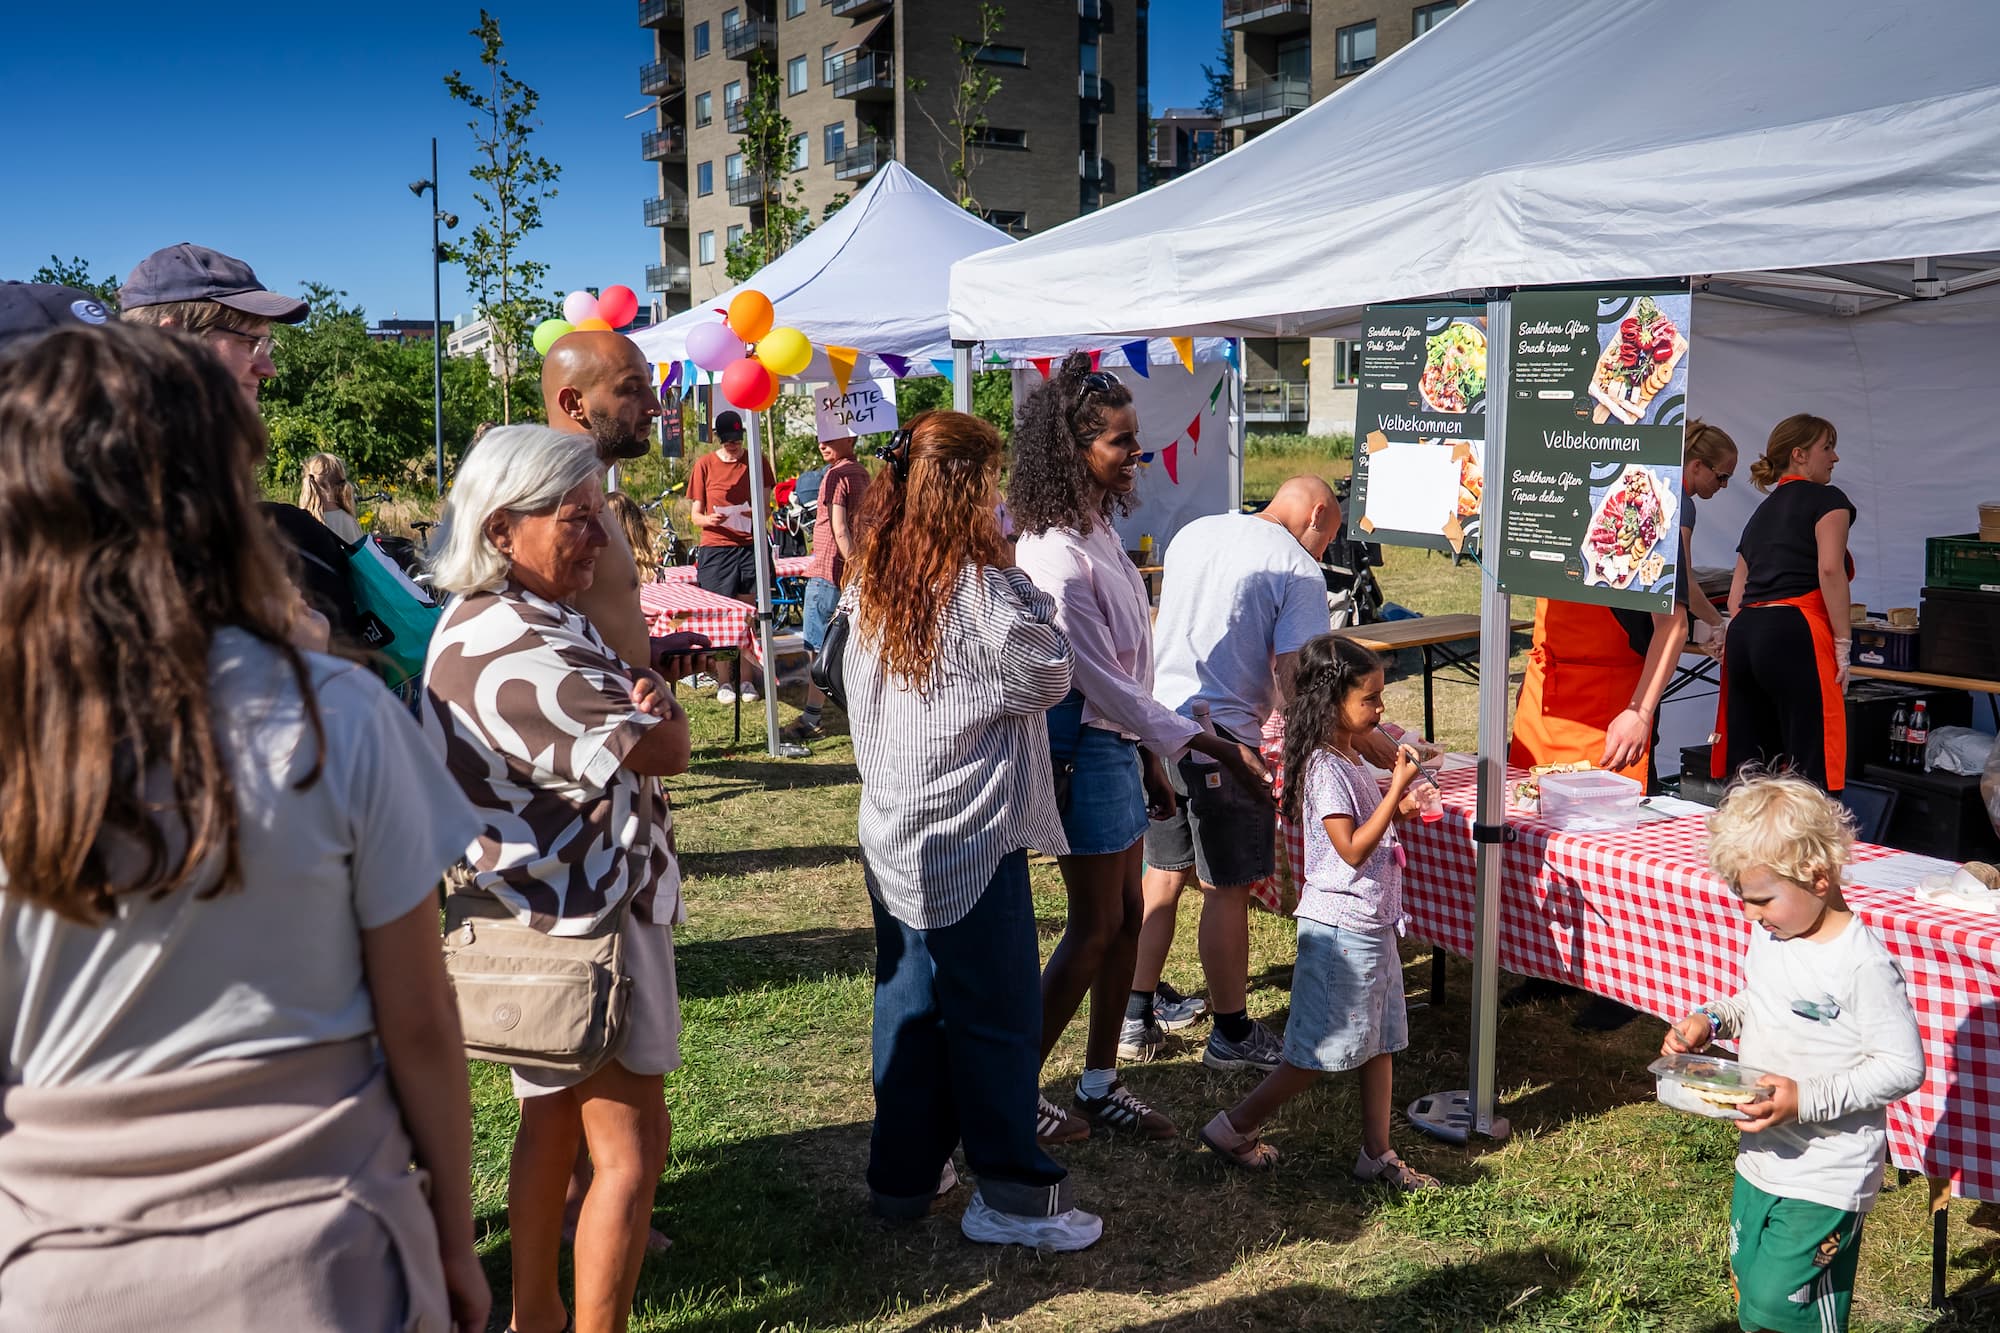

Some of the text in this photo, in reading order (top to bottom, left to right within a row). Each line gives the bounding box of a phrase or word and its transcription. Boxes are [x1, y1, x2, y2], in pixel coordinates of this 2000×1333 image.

[1368, 325, 1421, 341] Sankthans Aften
[1518, 320, 1590, 340] Sankthans Aften
[1386, 340, 1406, 351] Bowl
[1518, 340, 1571, 357] Snack tapas
[834, 406, 877, 425] JAGT
[1378, 414, 1462, 434] Velbekommen
[1543, 430, 1640, 451] Velbekommen
[1512, 469, 1583, 491] Sankthans Aften
[1511, 488, 1565, 505] Tapas delux
